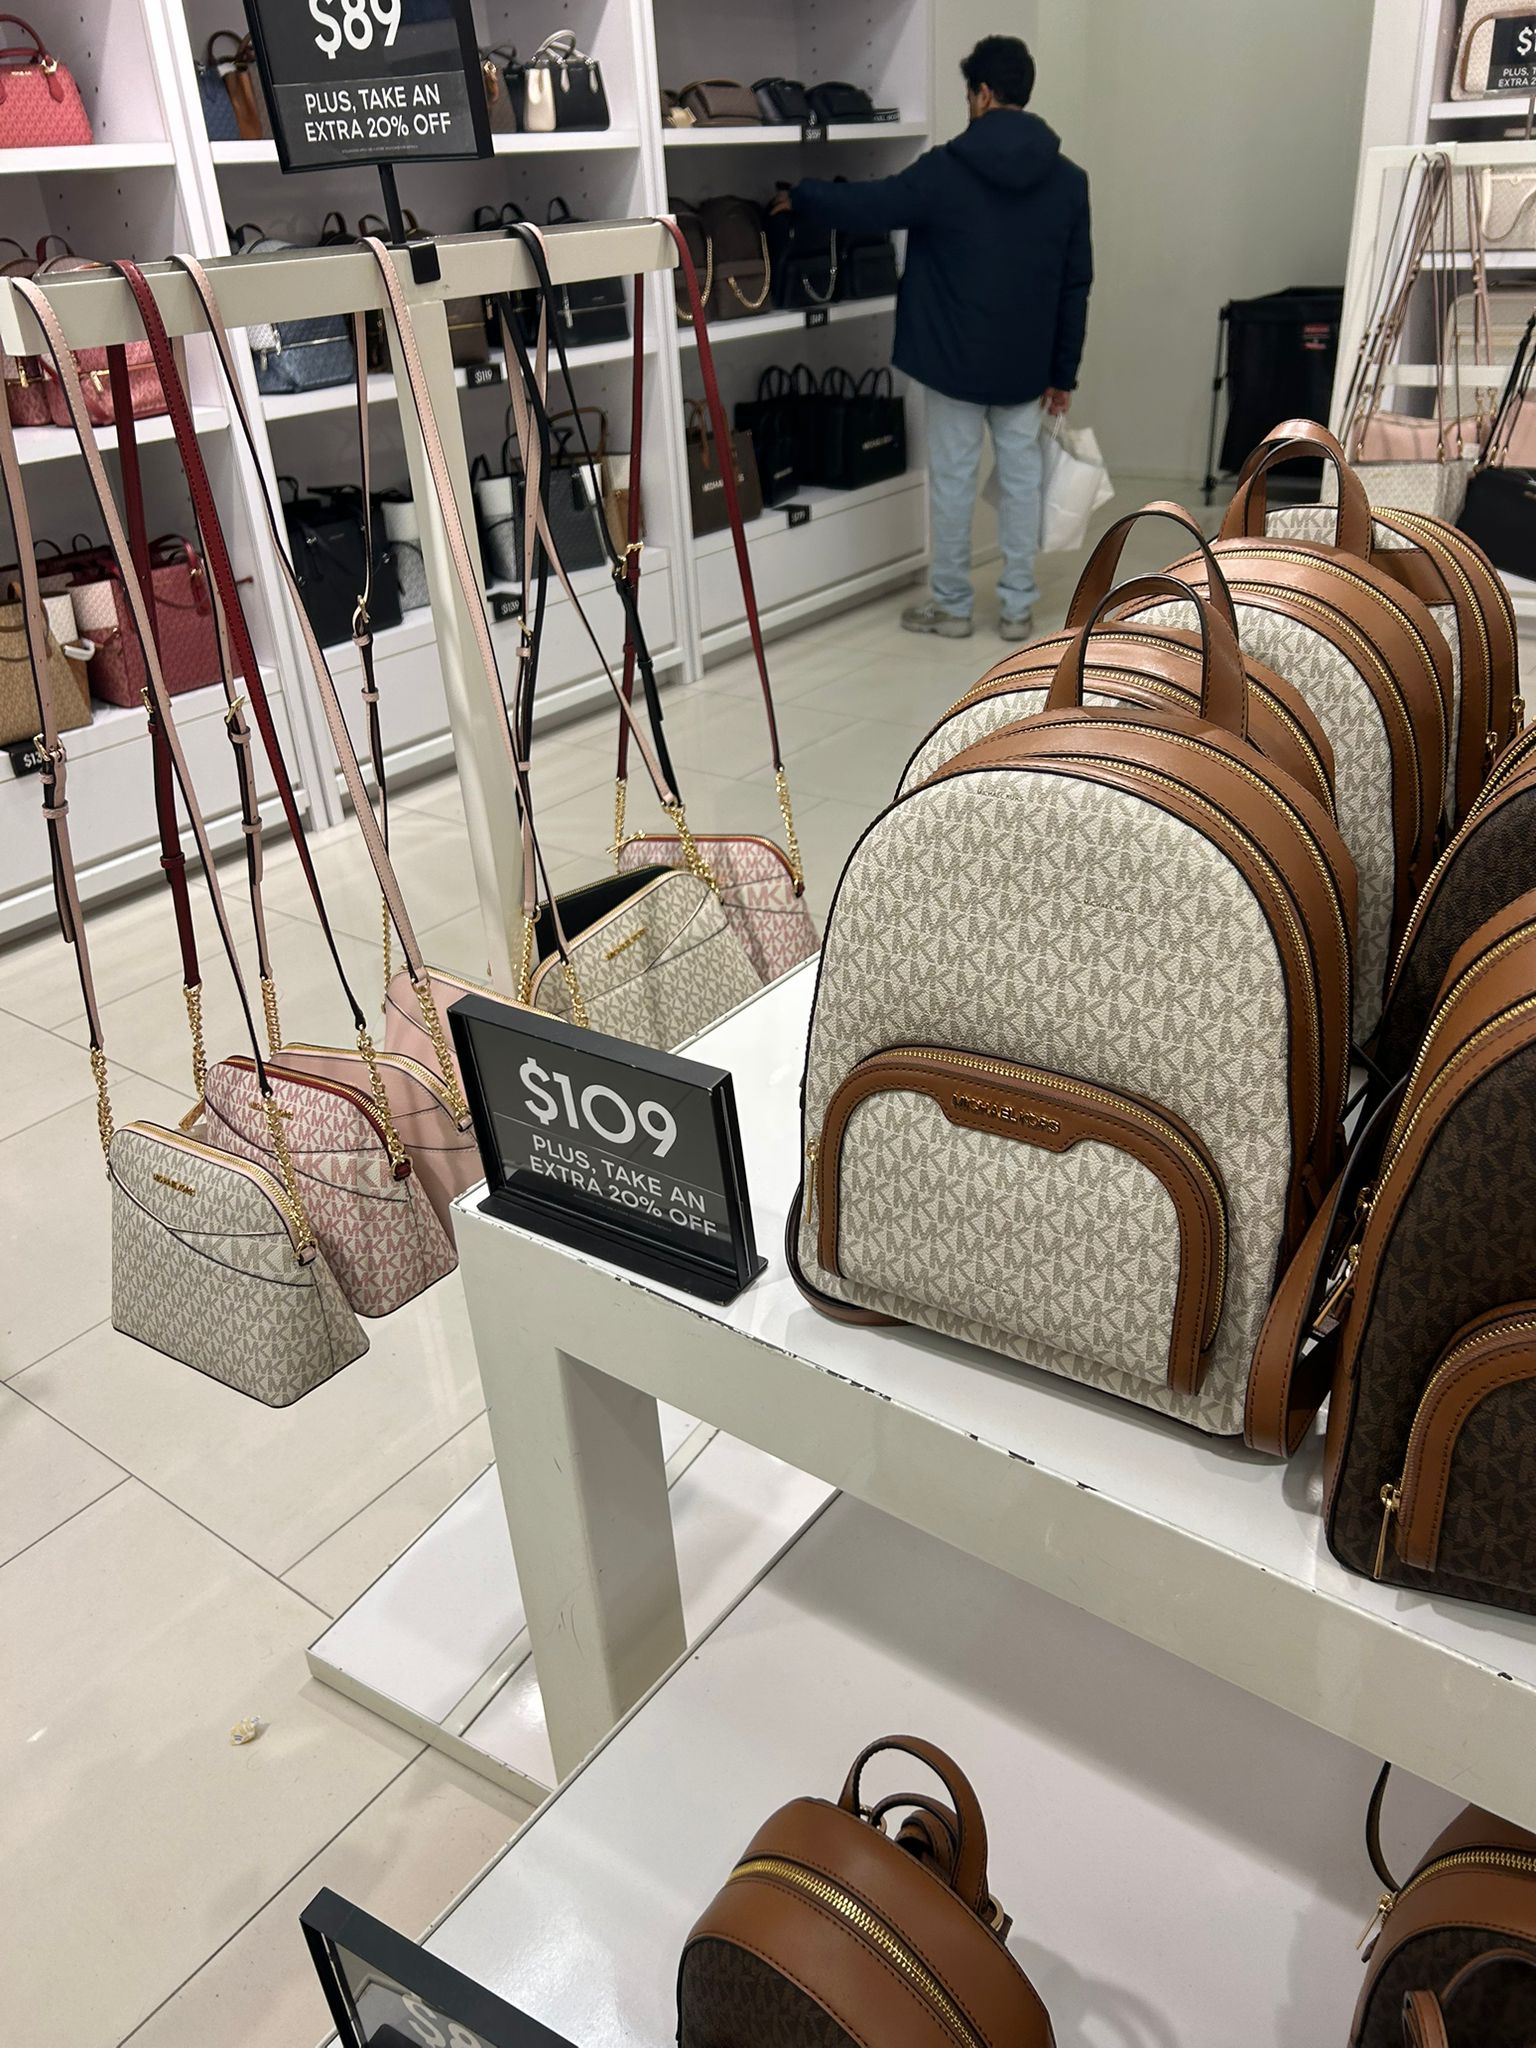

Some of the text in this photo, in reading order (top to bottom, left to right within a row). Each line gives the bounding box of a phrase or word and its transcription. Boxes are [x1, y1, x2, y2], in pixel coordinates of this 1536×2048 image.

[308, 0, 402, 60] $89
[305, 83, 441, 114] PLUS, TAKE AN
[1498, 79, 1528, 87] EXTRA
[305, 112, 451, 142] EXTRA 20% OFF
[23, 751, 43, 768] $13
[519, 1057, 677, 1158] $109
[952, 1093, 1061, 1133] MICHAEL KORS
[532, 1134, 596, 1174] PLUS,
[601, 1158, 662, 1197] TAKE
[670, 1186, 706, 1213] AN
[530, 1155, 603, 1196] EXTRA
[609, 1184, 663, 1217] 20%
[669, 1207, 718, 1236] OFF
